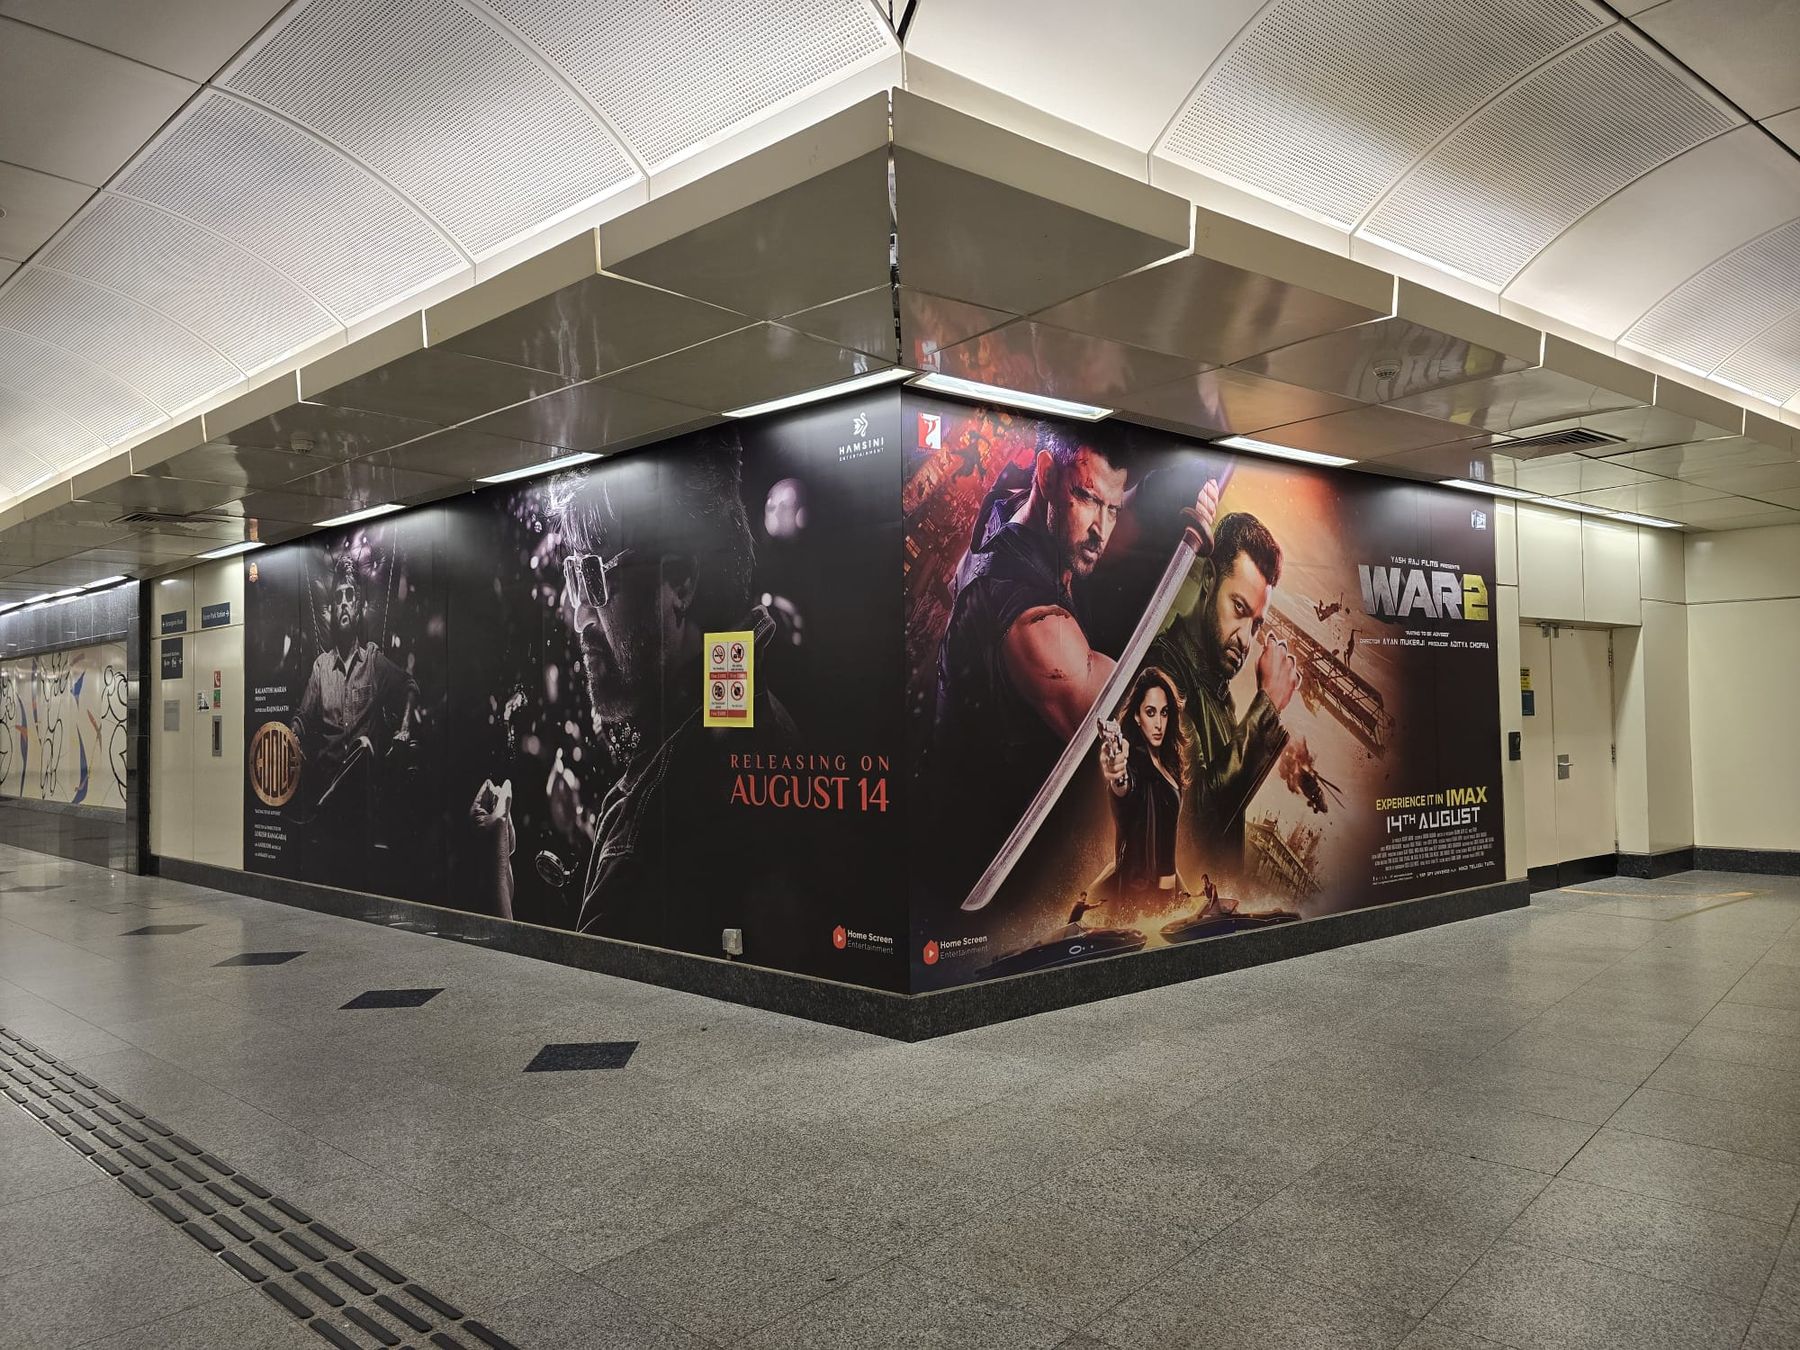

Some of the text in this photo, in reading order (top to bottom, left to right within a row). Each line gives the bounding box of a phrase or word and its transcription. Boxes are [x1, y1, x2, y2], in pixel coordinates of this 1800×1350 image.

[839, 436, 884, 455] HAMSINI
[839, 447, 884, 462] ENTERTAINMENT
[1390, 556, 1406, 564] YASH
[1408, 557, 1420, 566] RAJ
[1421, 559, 1439, 568] FILMS
[1358, 564, 1489, 621] WAR 2
[1382, 638, 1399, 646] AYAN
[1450, 640, 1468, 649] ADITYA
[1469, 641, 1489, 649] CHOPRA
[730, 754, 890, 771] RELEASING ON
[730, 774, 890, 812] AUGUST 14
[1376, 786, 1488, 811] EXPERIENCE IT IN IMAX
[1387, 806, 1481, 834] 14TH AUGUST
[847, 930, 894, 945] Home Screen
[940, 934, 988, 950] Home Screen
[847, 940, 894, 955] Entertainment
[940, 944, 989, 961] Entertainment
